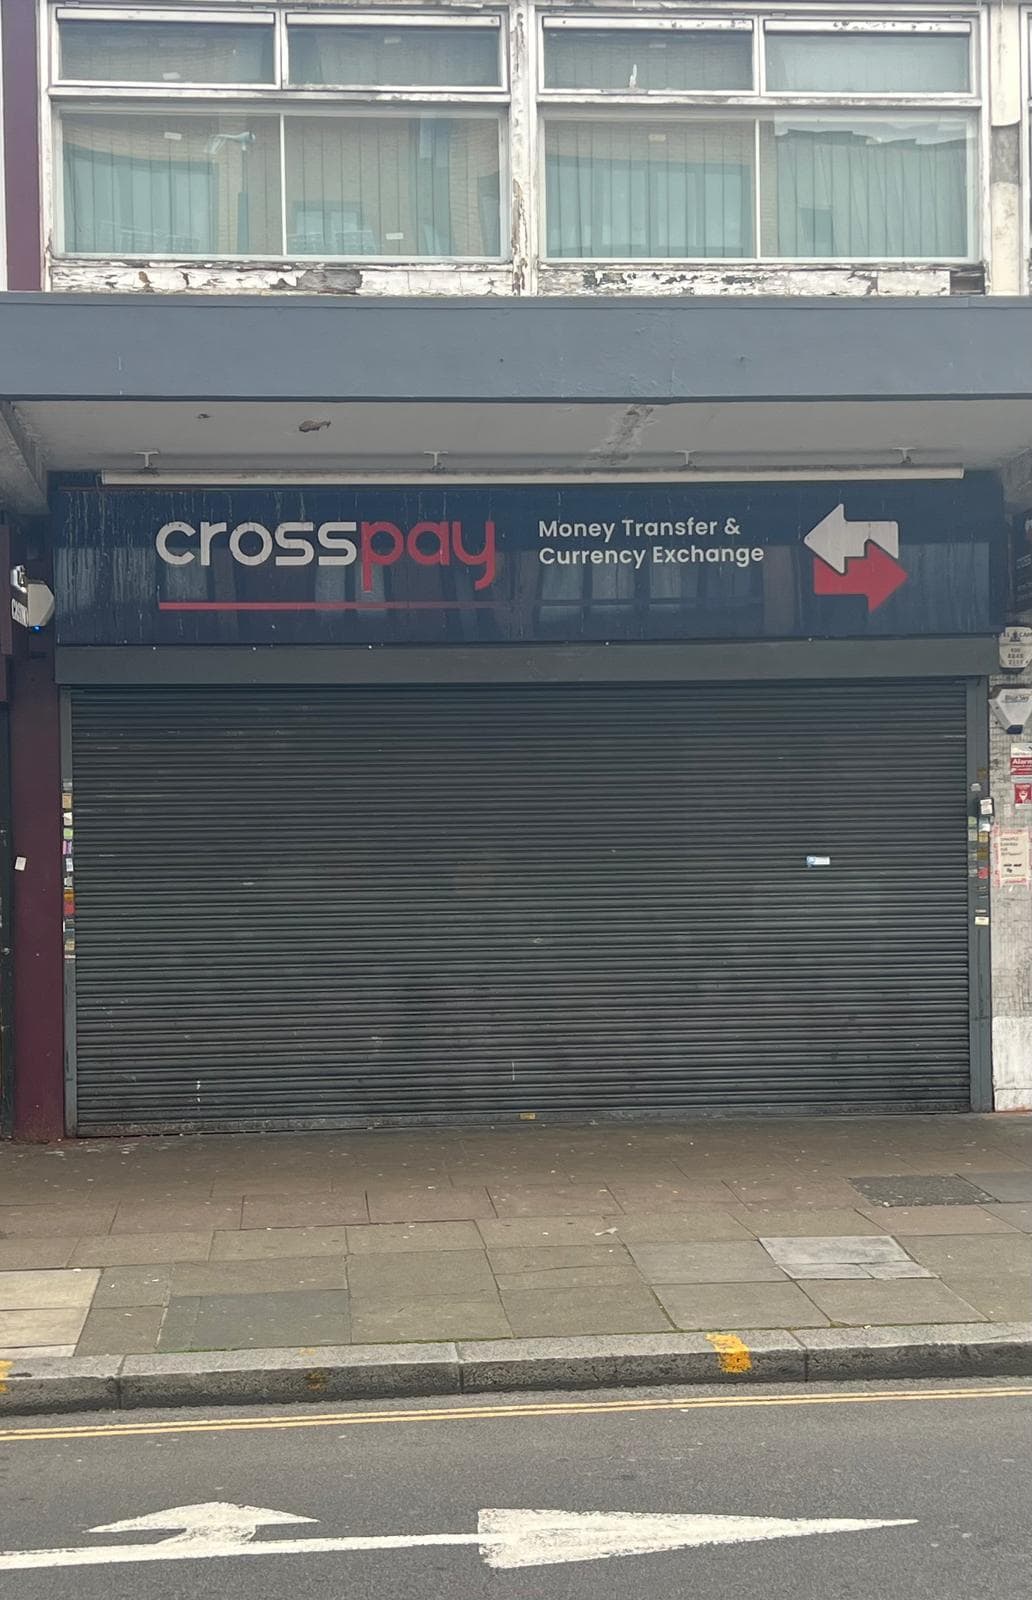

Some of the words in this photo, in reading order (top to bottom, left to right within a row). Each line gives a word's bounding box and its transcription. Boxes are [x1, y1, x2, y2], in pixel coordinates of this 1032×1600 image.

[538, 520, 615, 542] Money
[621, 517, 718, 537] Transfer
[724, 517, 741, 535] &
[155, 521, 496, 592] crosspay
[538, 547, 646, 569] Currency
[652, 545, 764, 568] Exchange
